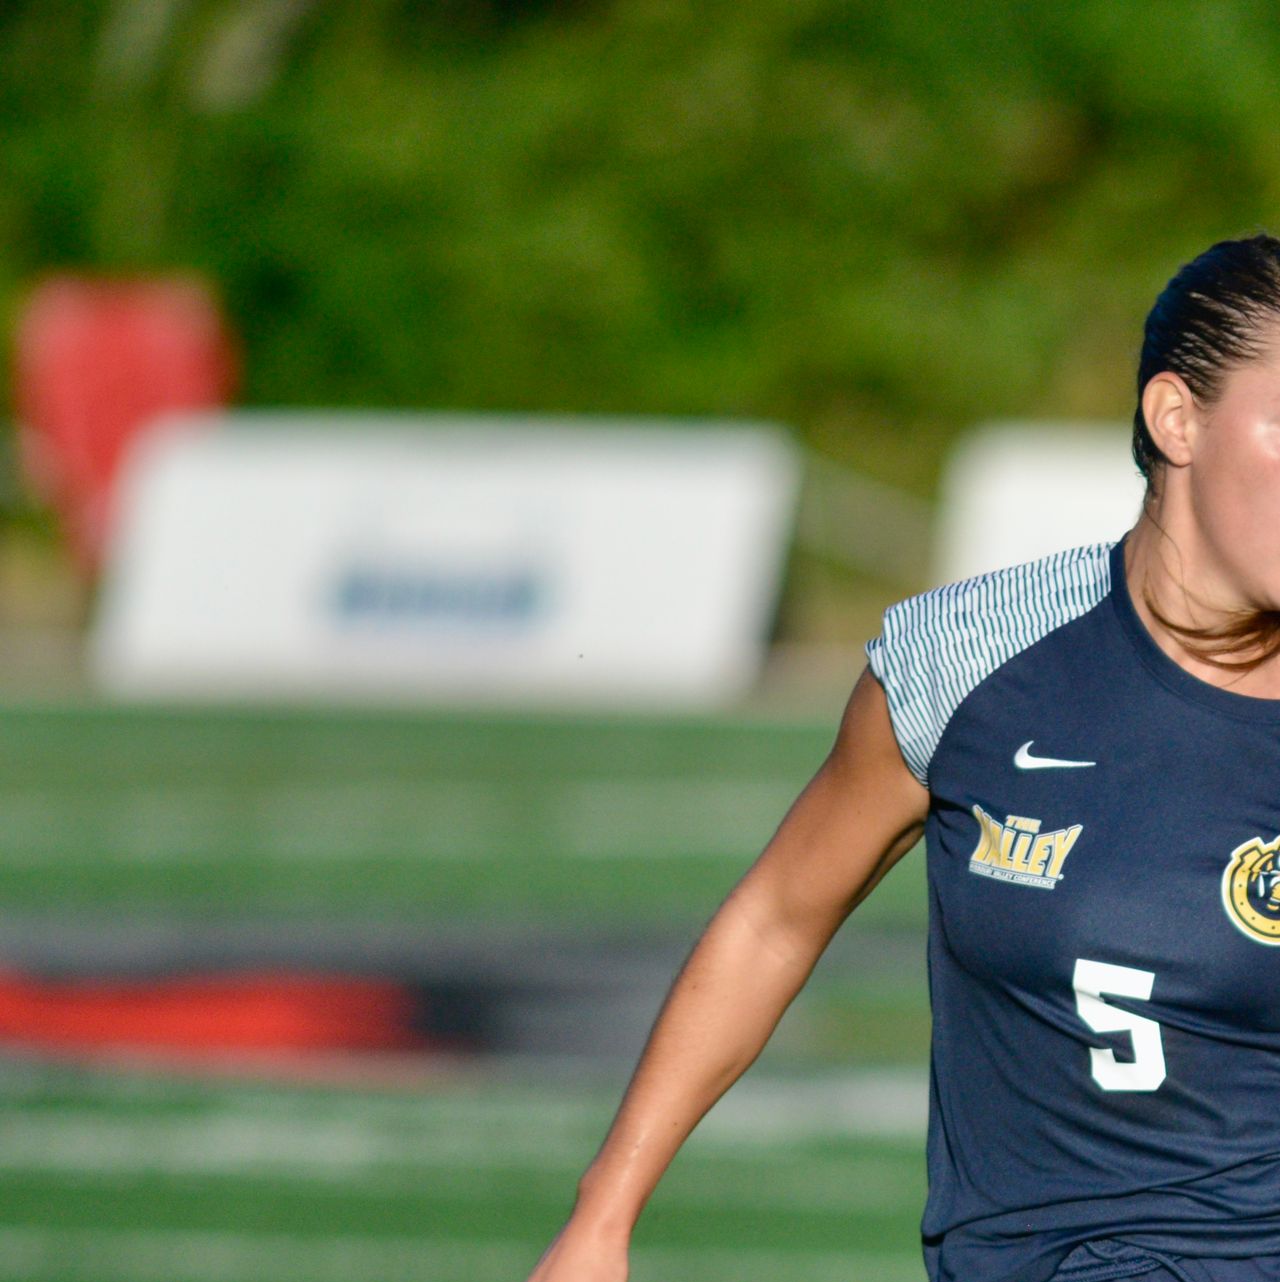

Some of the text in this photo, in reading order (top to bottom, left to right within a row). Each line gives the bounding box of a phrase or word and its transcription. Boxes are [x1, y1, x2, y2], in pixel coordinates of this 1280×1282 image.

[972, 804, 1083, 879] VALLEY
[1005, 815, 1042, 833] THE
[1072, 958, 1167, 1091] 5
